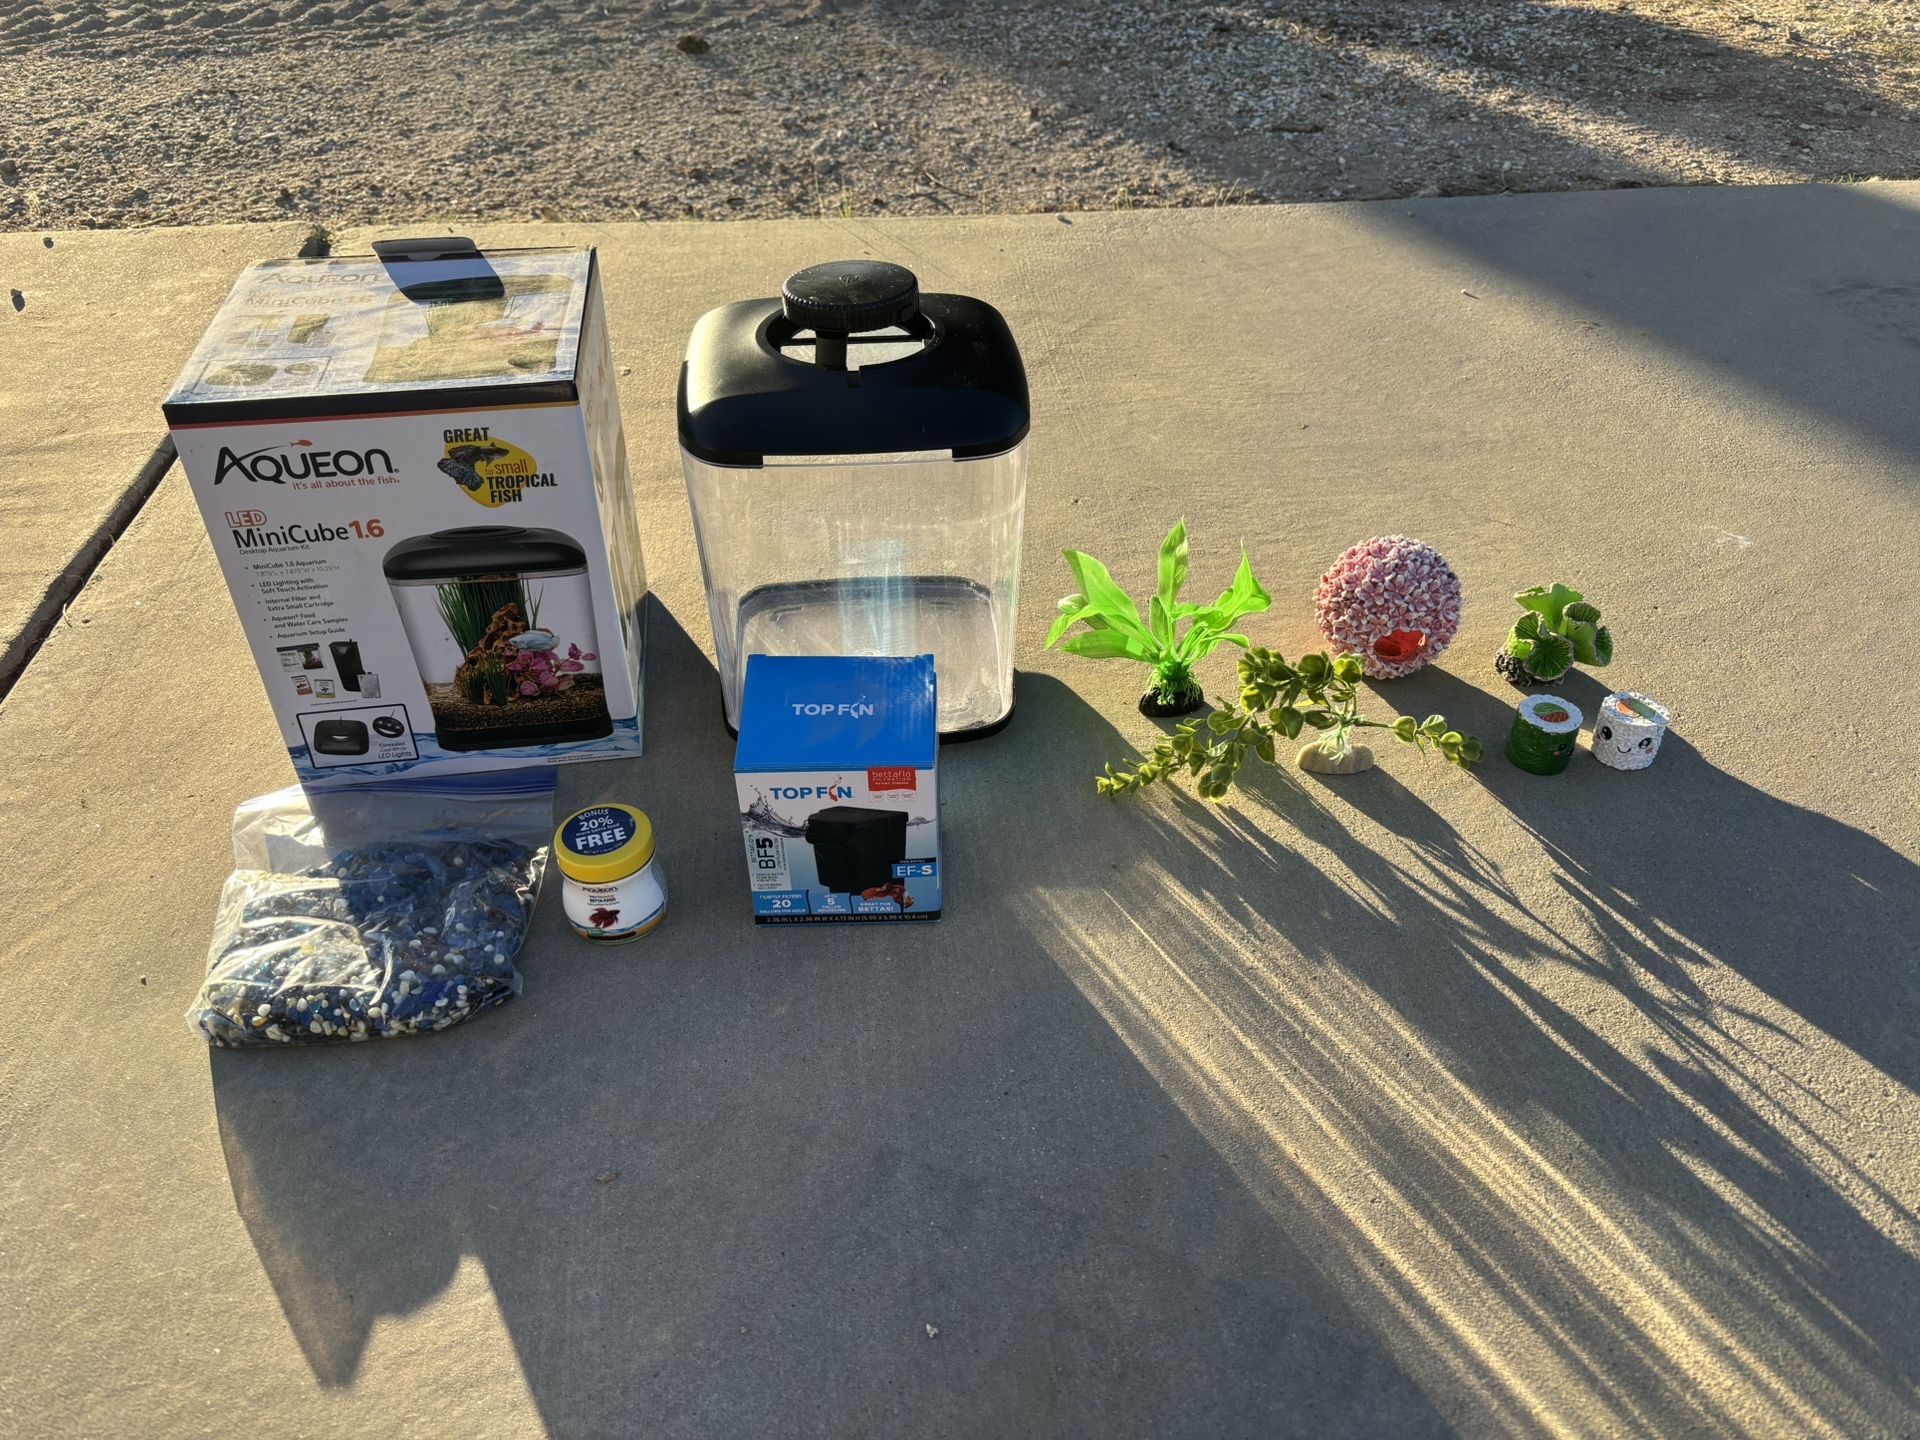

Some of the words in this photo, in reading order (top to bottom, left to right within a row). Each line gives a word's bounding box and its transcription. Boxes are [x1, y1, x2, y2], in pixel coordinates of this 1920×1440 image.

[443, 427, 489, 444] GREAT
[214, 446, 393, 486] AQUEON
[485, 467, 494, 476] for
[495, 458, 528, 475] small
[311, 481, 322, 489] all
[326, 479, 356, 488] about
[358, 478, 375, 486] the
[486, 473, 558, 490] TROPICAL
[490, 489, 523, 503] FISH
[225, 509, 267, 528] LED
[232, 522, 349, 549] MiniCube
[268, 545, 299, 553] Aquarium
[253, 562, 283, 570] MiniCube
[296, 559, 327, 567] Aquarium
[273, 579, 299, 587] Lighting
[297, 583, 328, 591] Activation
[303, 600, 334, 608] Cartridge
[322, 617, 348, 625] Samples
[278, 630, 307, 639] Aquarium
[308, 628, 327, 636] Setup
[792, 703, 835, 716] TOP
[769, 787, 813, 800] TOP
[578, 808, 609, 820] BONUS
[579, 815, 614, 831] 20%
[575, 827, 627, 851] FREE
[756, 838, 776, 869] BF5
[896, 865, 933, 877] EF-S
[772, 899, 792, 909] 20
[827, 897, 836, 906] 5
